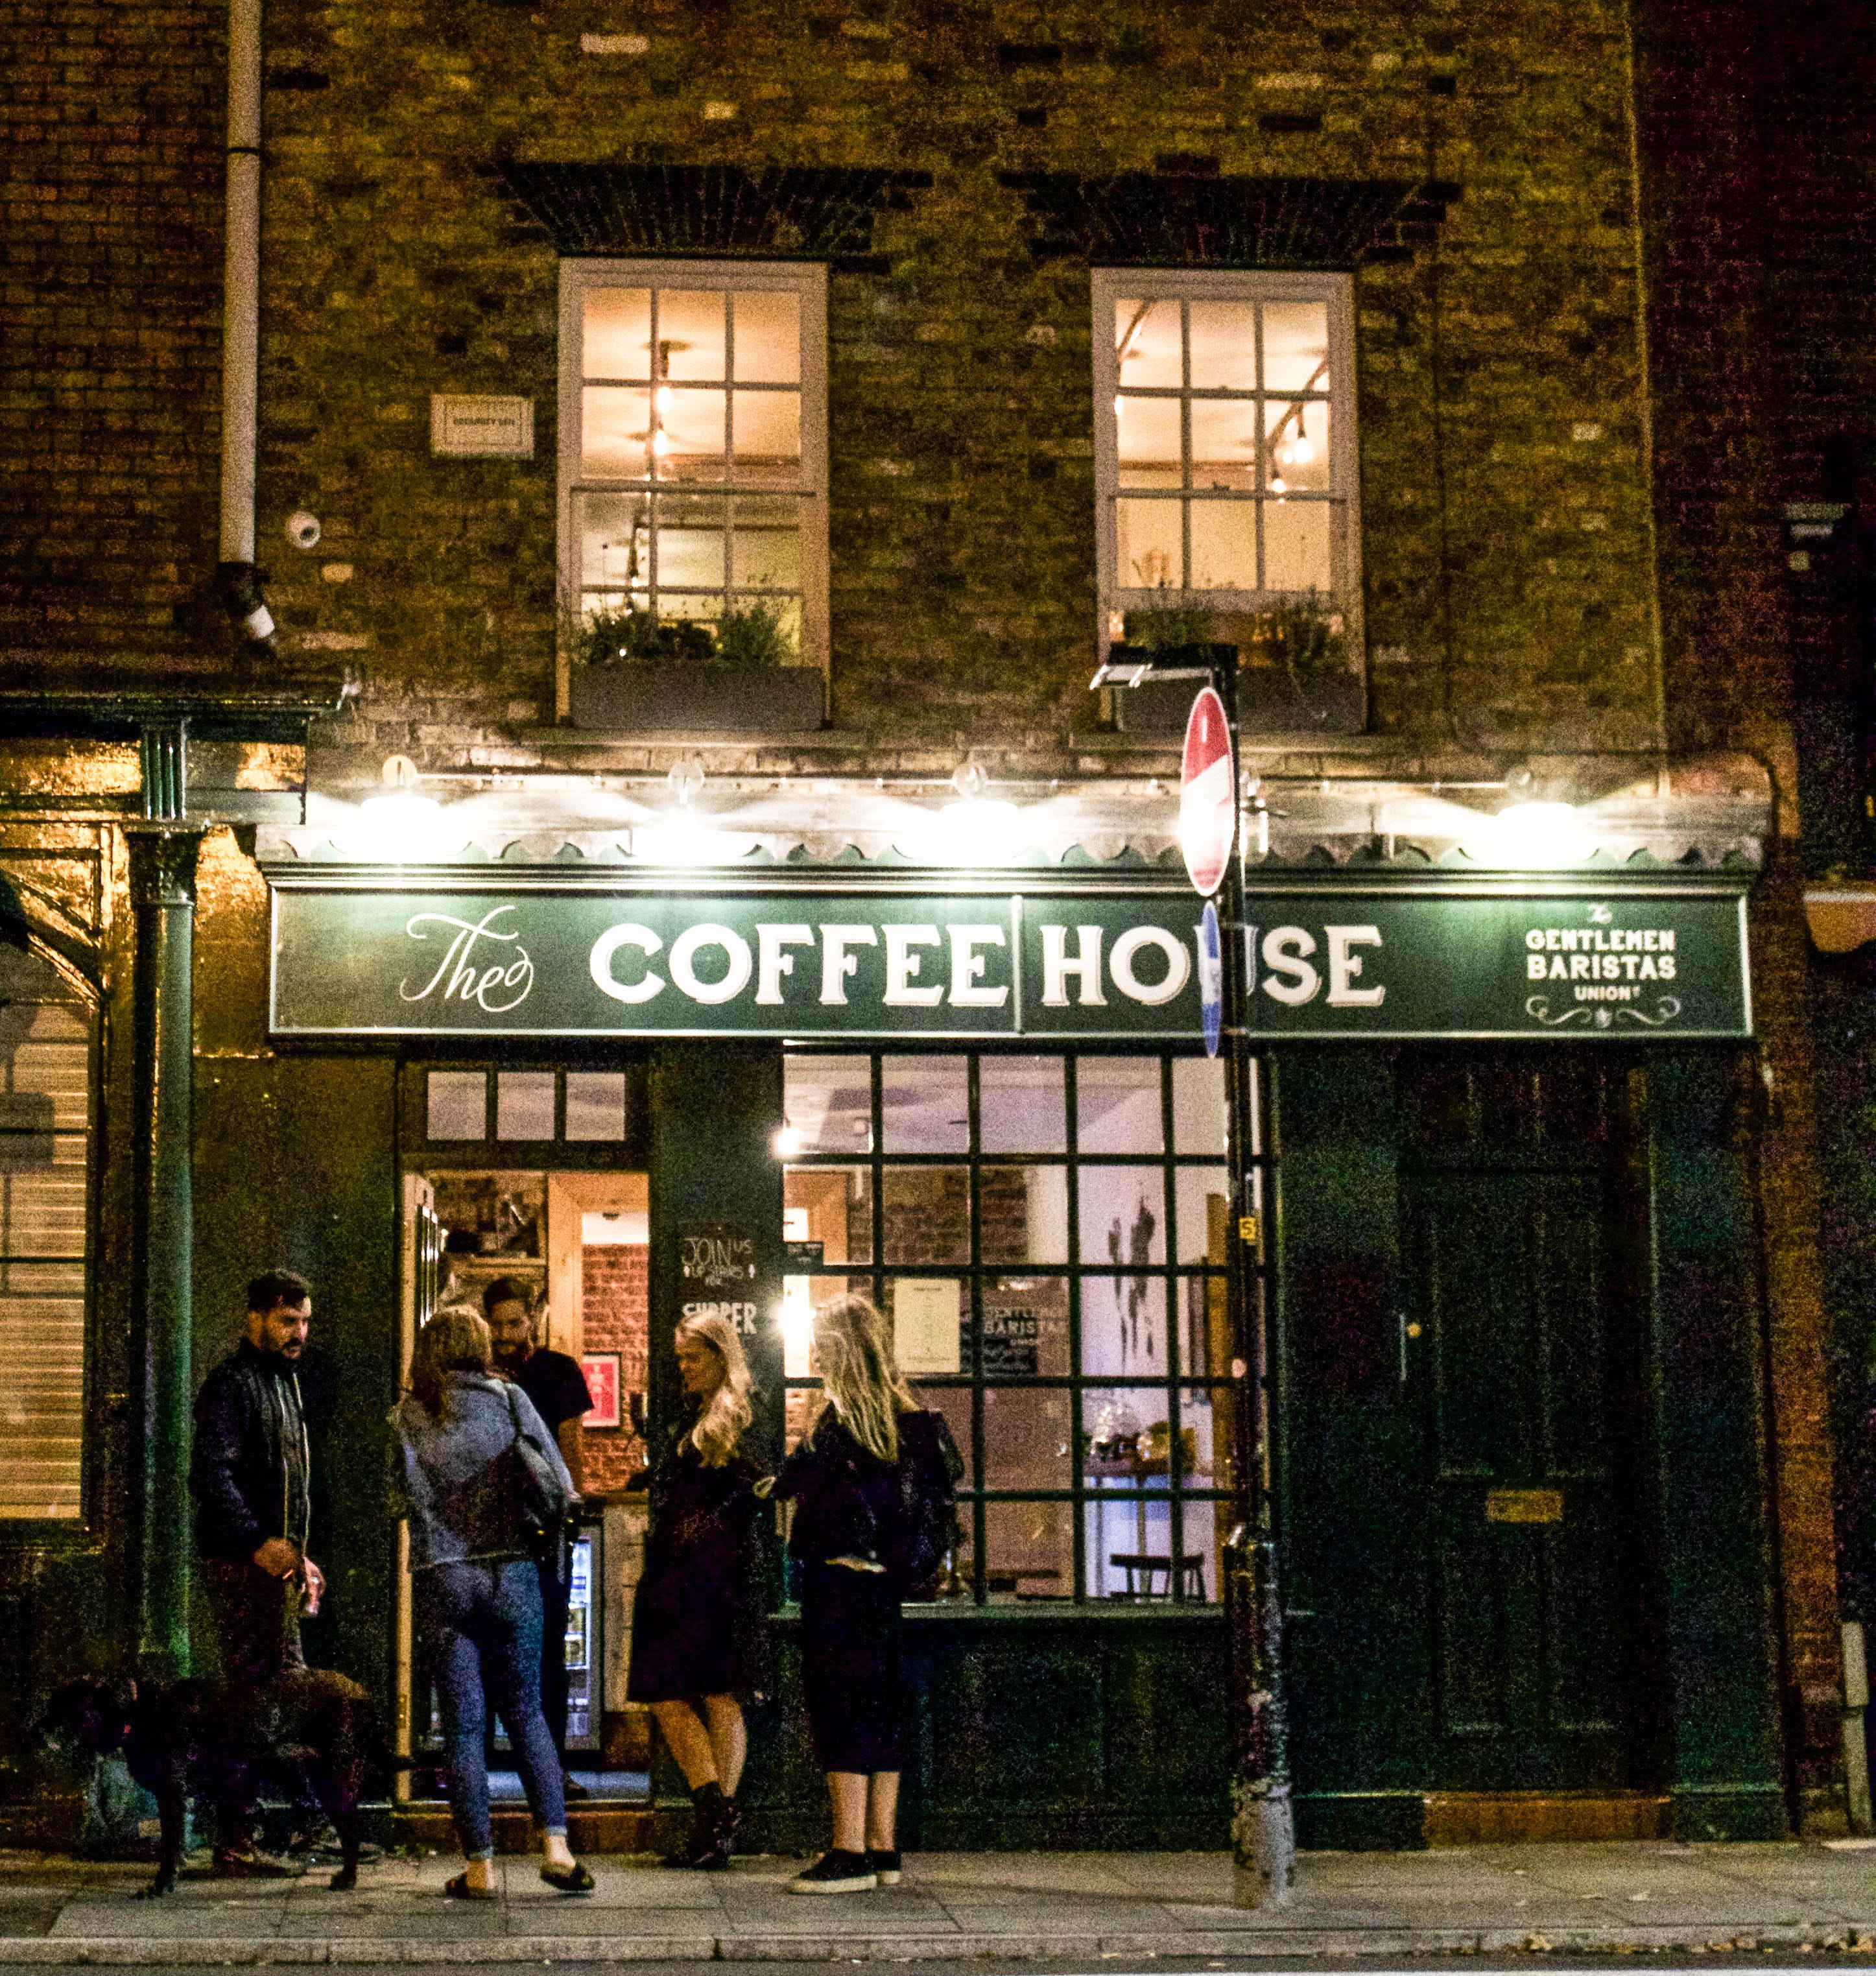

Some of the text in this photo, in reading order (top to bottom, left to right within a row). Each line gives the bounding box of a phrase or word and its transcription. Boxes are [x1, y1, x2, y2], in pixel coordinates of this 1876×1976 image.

[1526, 929, 1676, 951] GENTLEMEN
[589, 923, 1008, 1007] COFFEE
[1527, 955, 1677, 980] BARISTAS
[682, 1237, 731, 1265] JOIN
